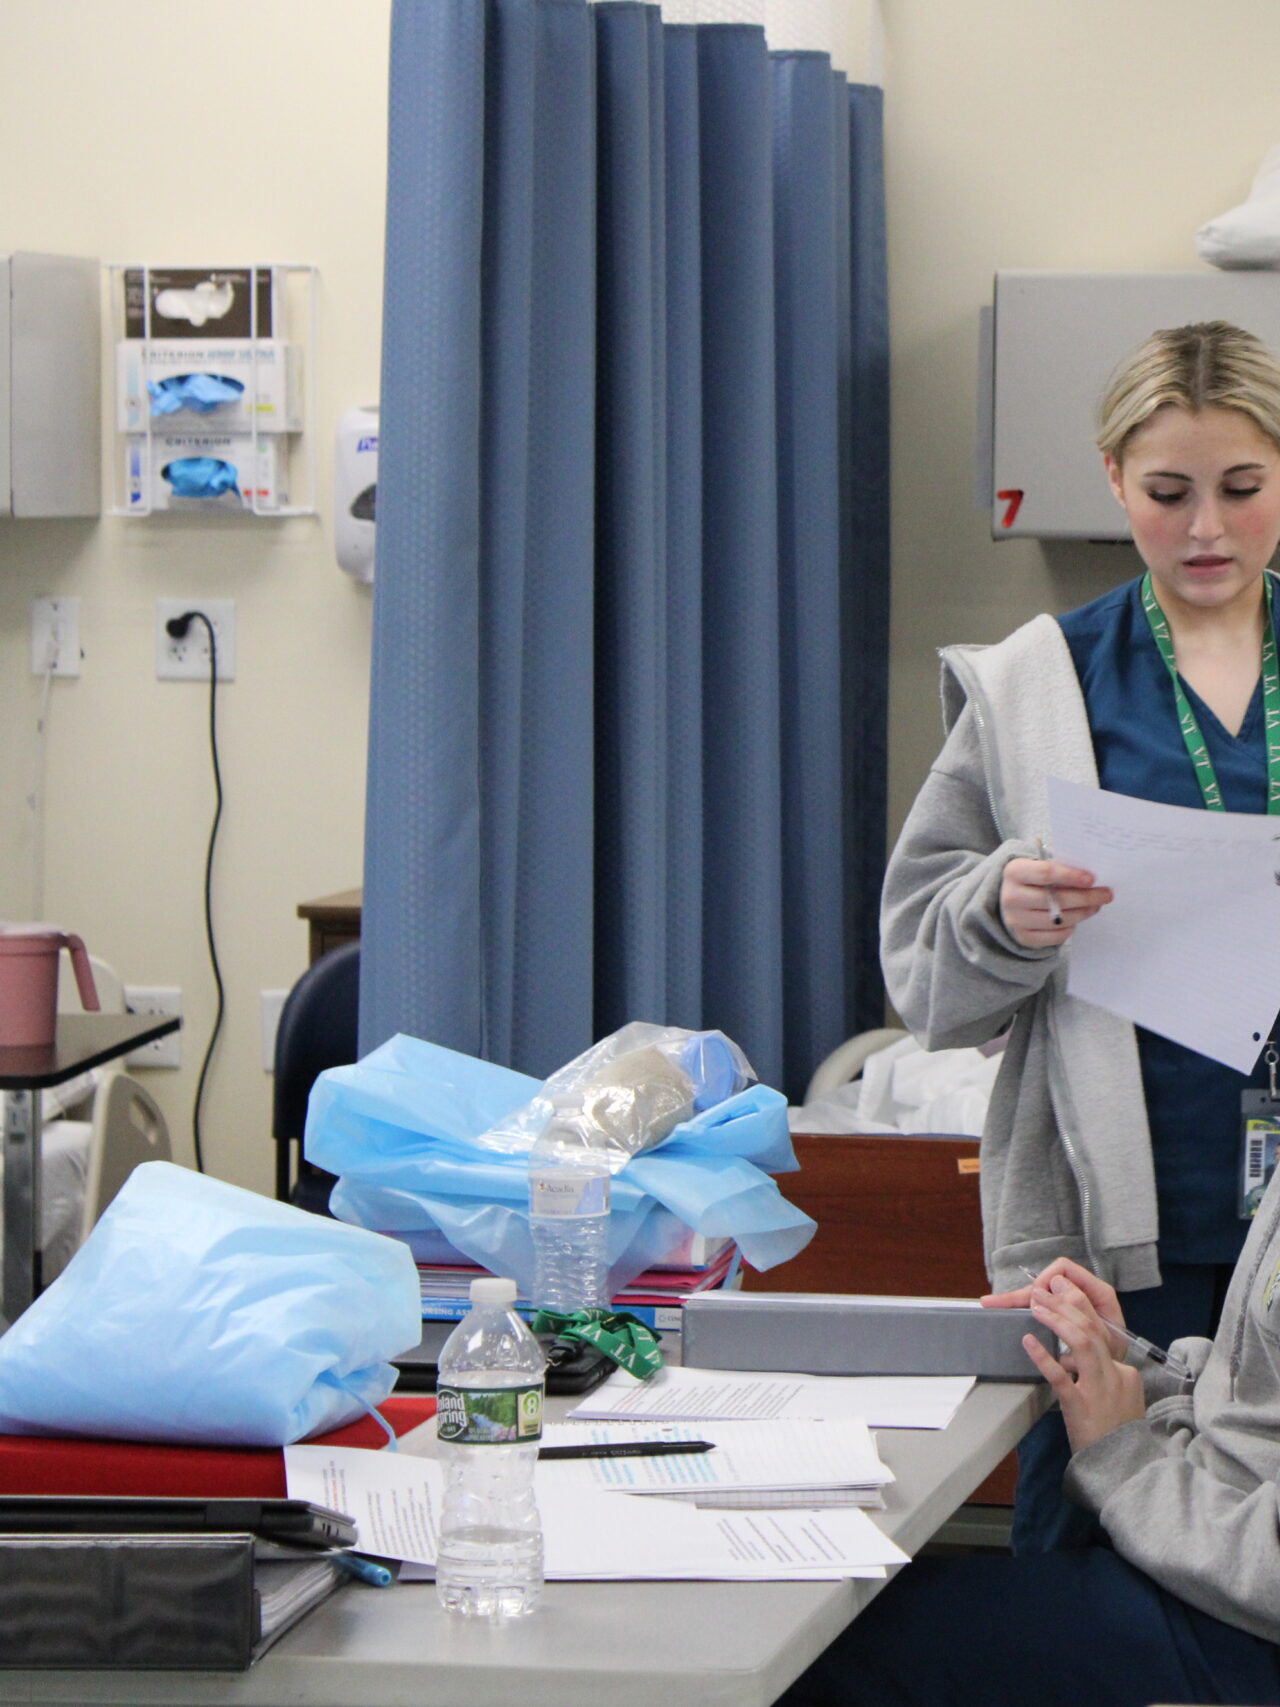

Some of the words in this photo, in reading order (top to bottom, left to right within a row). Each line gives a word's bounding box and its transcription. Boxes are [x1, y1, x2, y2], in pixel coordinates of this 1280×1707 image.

[997, 489, 1025, 528] 7
[1264, 675, 1278, 695] VT
[1266, 708, 1280, 729] VT
[1181, 712, 1198, 735] VT
[1193, 746, 1211, 768] VT
[1204, 783, 1221, 806] VT
[420, 1307, 453, 1316] URSING
[438, 1393, 465, 1411] oland
[439, 1410, 467, 1428] pring
